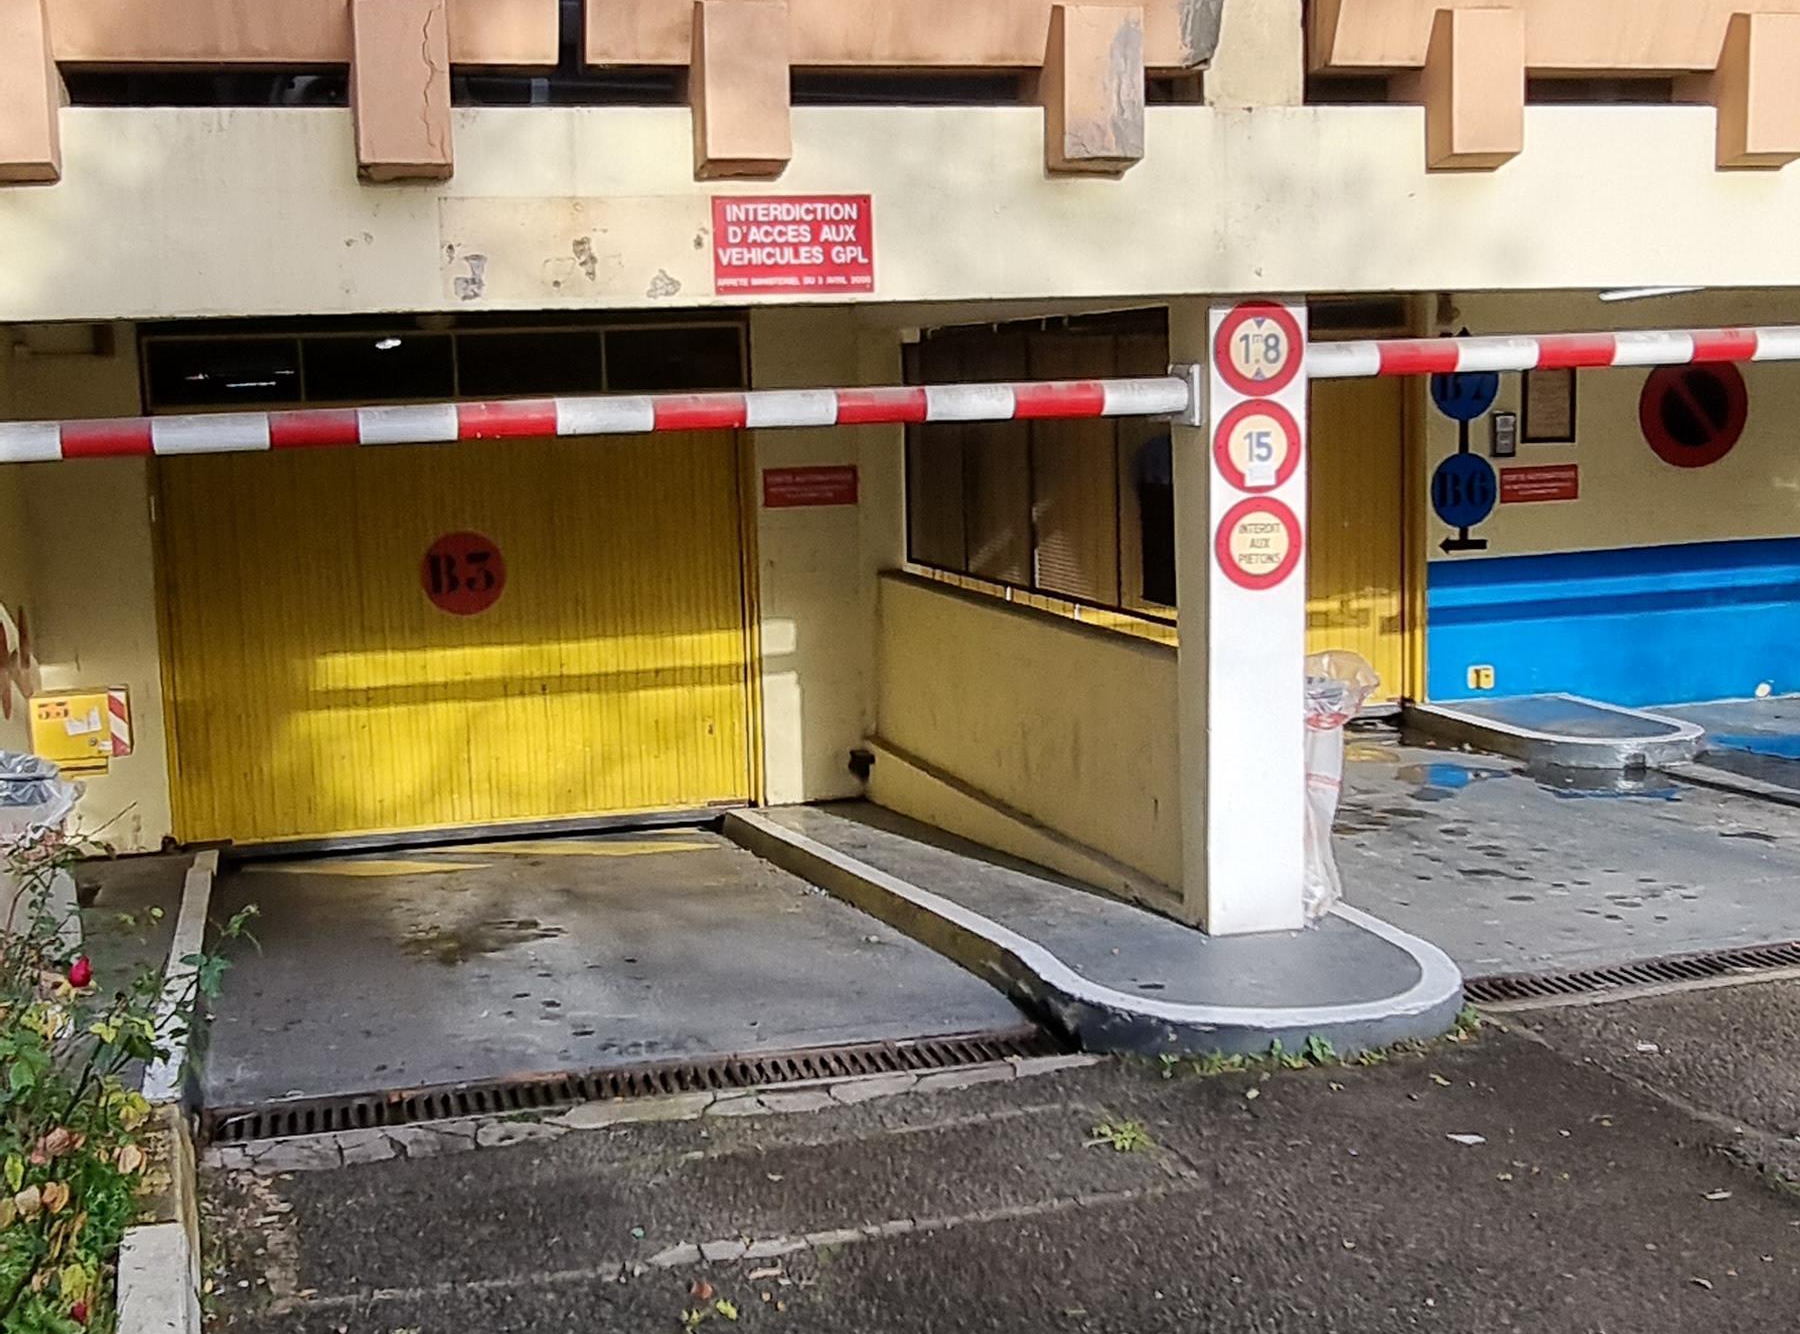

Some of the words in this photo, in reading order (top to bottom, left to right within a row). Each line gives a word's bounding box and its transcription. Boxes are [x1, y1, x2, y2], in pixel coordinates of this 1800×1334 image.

[726, 203, 858, 222] INTERDICTION
[727, 225, 812, 244] D'ACCES
[819, 224, 857, 243] AUX
[717, 246, 824, 266] VEHICULES
[831, 246, 869, 264] GPL
[1243, 431, 1273, 462] 15
[1440, 473, 1489, 507] B6
[1249, 537, 1271, 549] AUX
[1239, 553, 1281, 565] PIETONS
